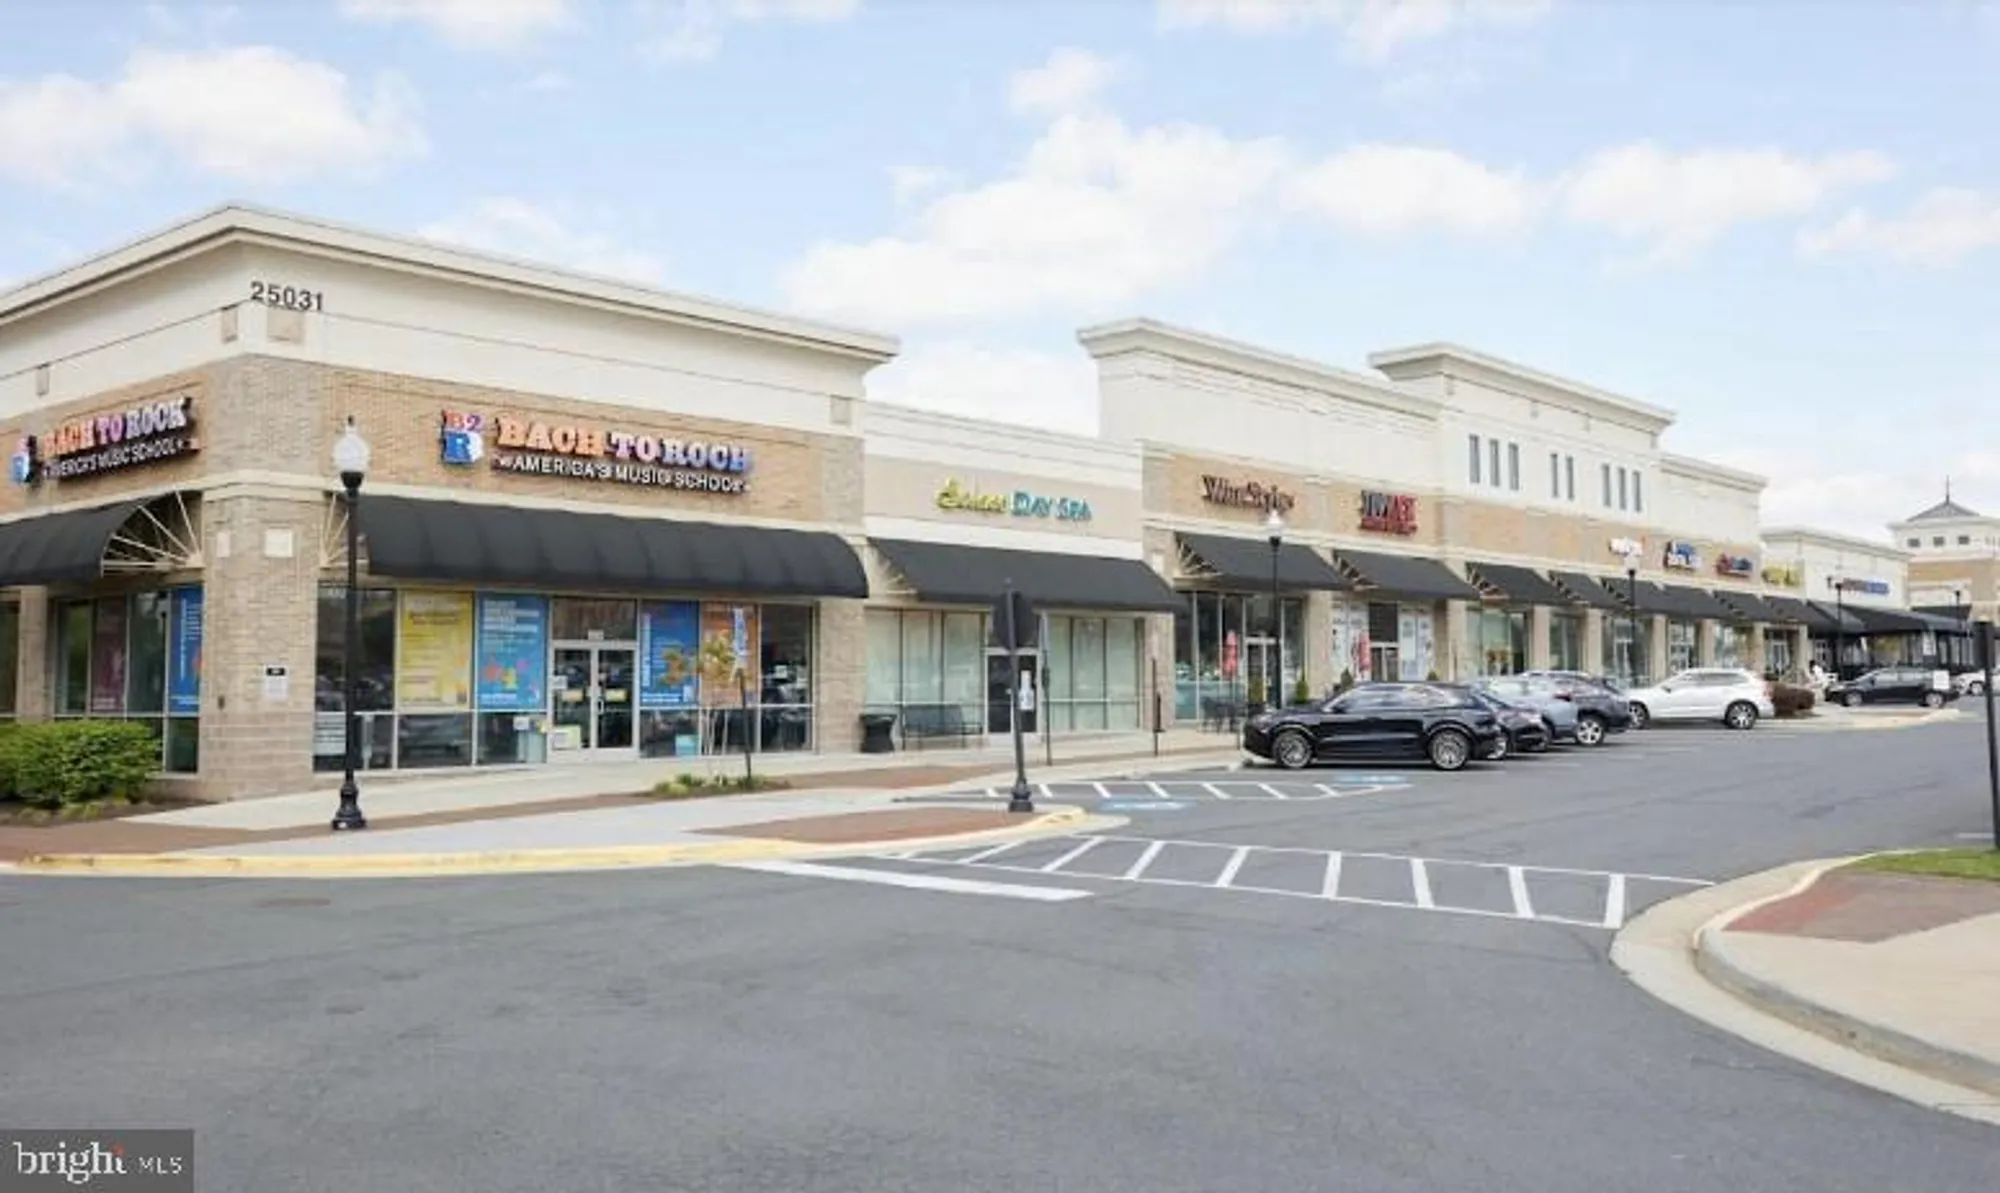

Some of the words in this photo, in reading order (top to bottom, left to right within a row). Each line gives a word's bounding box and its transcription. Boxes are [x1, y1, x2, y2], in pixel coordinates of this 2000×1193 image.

[250, 281, 323, 311] 25031
[95, 412, 124, 445] TO
[496, 414, 605, 457] BACH
[606, 430, 659, 462] TO
[513, 452, 613, 479] AMERICA'S
[615, 462, 672, 486] MUSIC
